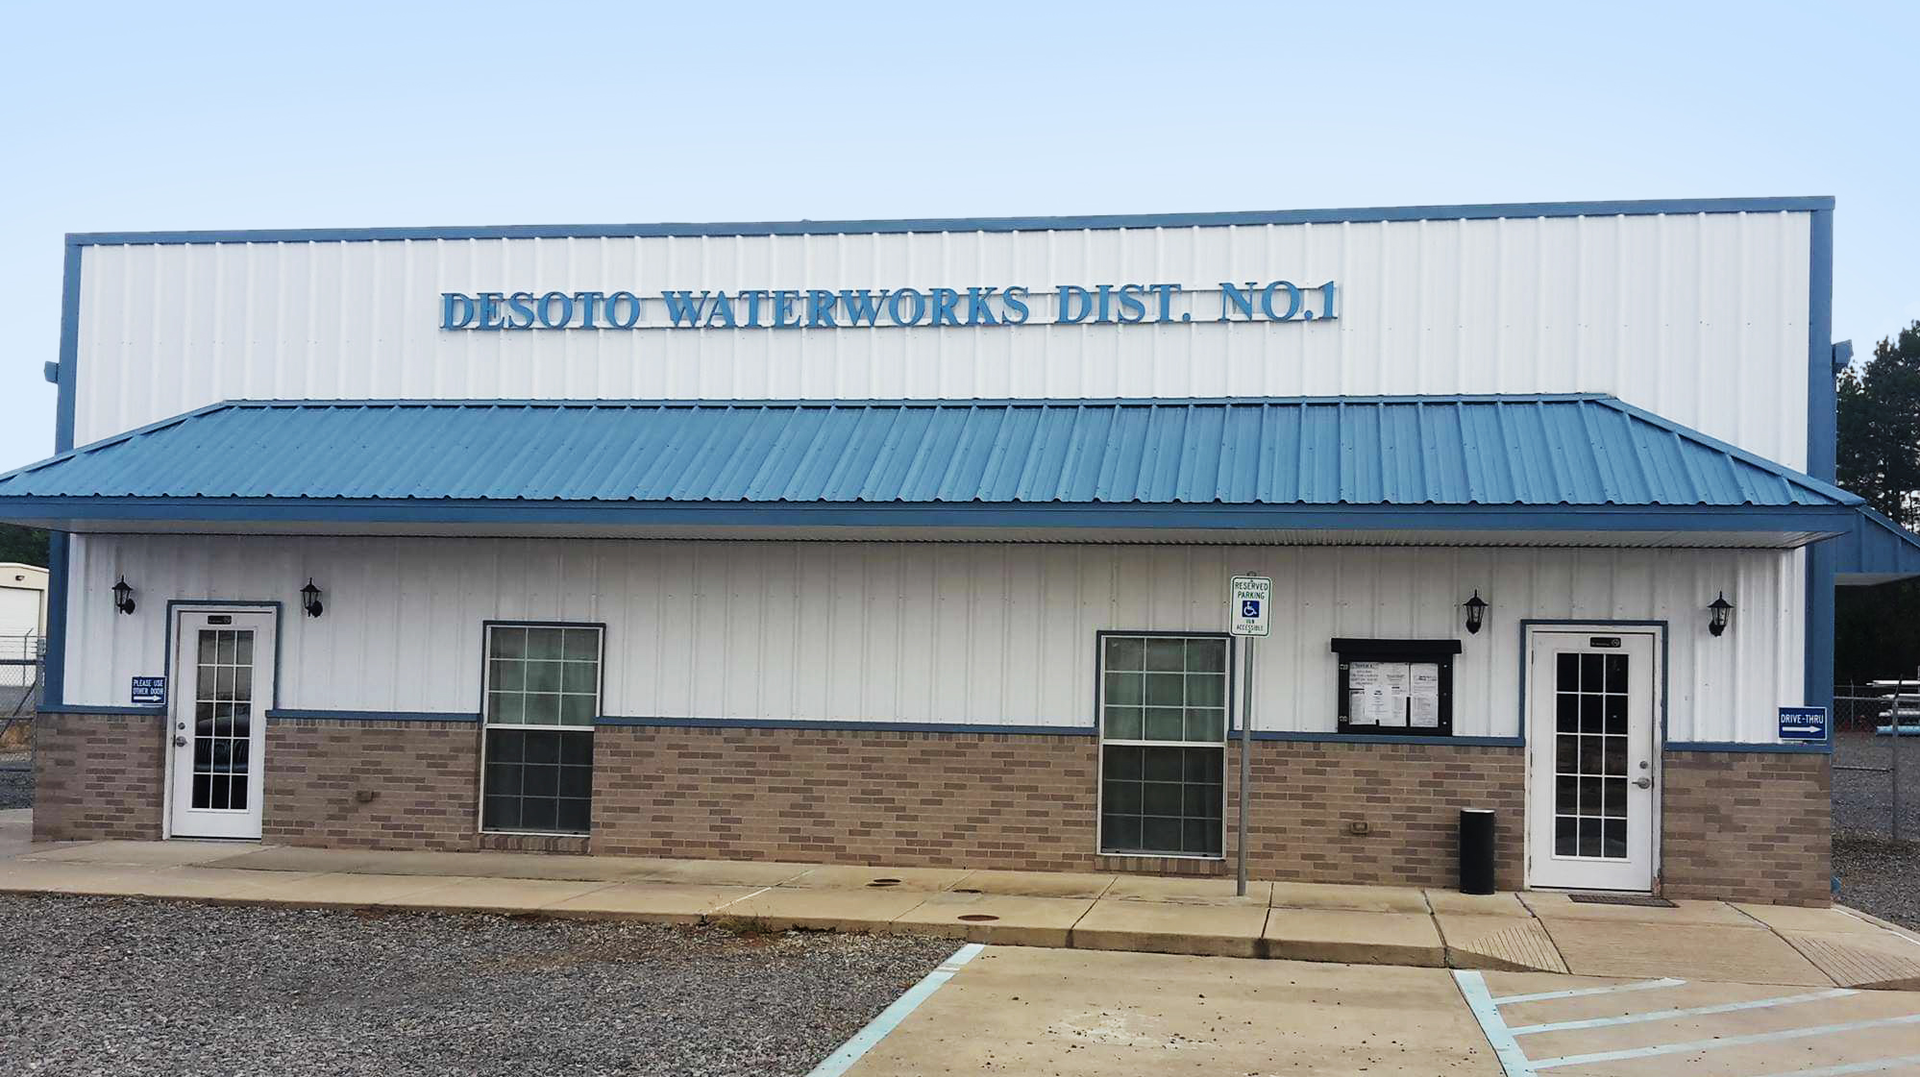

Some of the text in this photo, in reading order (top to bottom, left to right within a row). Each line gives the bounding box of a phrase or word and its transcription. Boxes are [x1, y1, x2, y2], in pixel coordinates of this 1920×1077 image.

[439, 291, 641, 330] DESOTO
[661, 286, 1030, 328] WATERWORKS
[1054, 283, 1192, 325] DIST.
[1235, 582, 1269, 591] RESERVED
[1237, 591, 1265, 600] PARKING
[133, 679, 164, 687] PLEASE USE
[132, 687, 164, 695] OTHER DOOR
[1780, 714, 1824, 724] DRIVE-THRU
